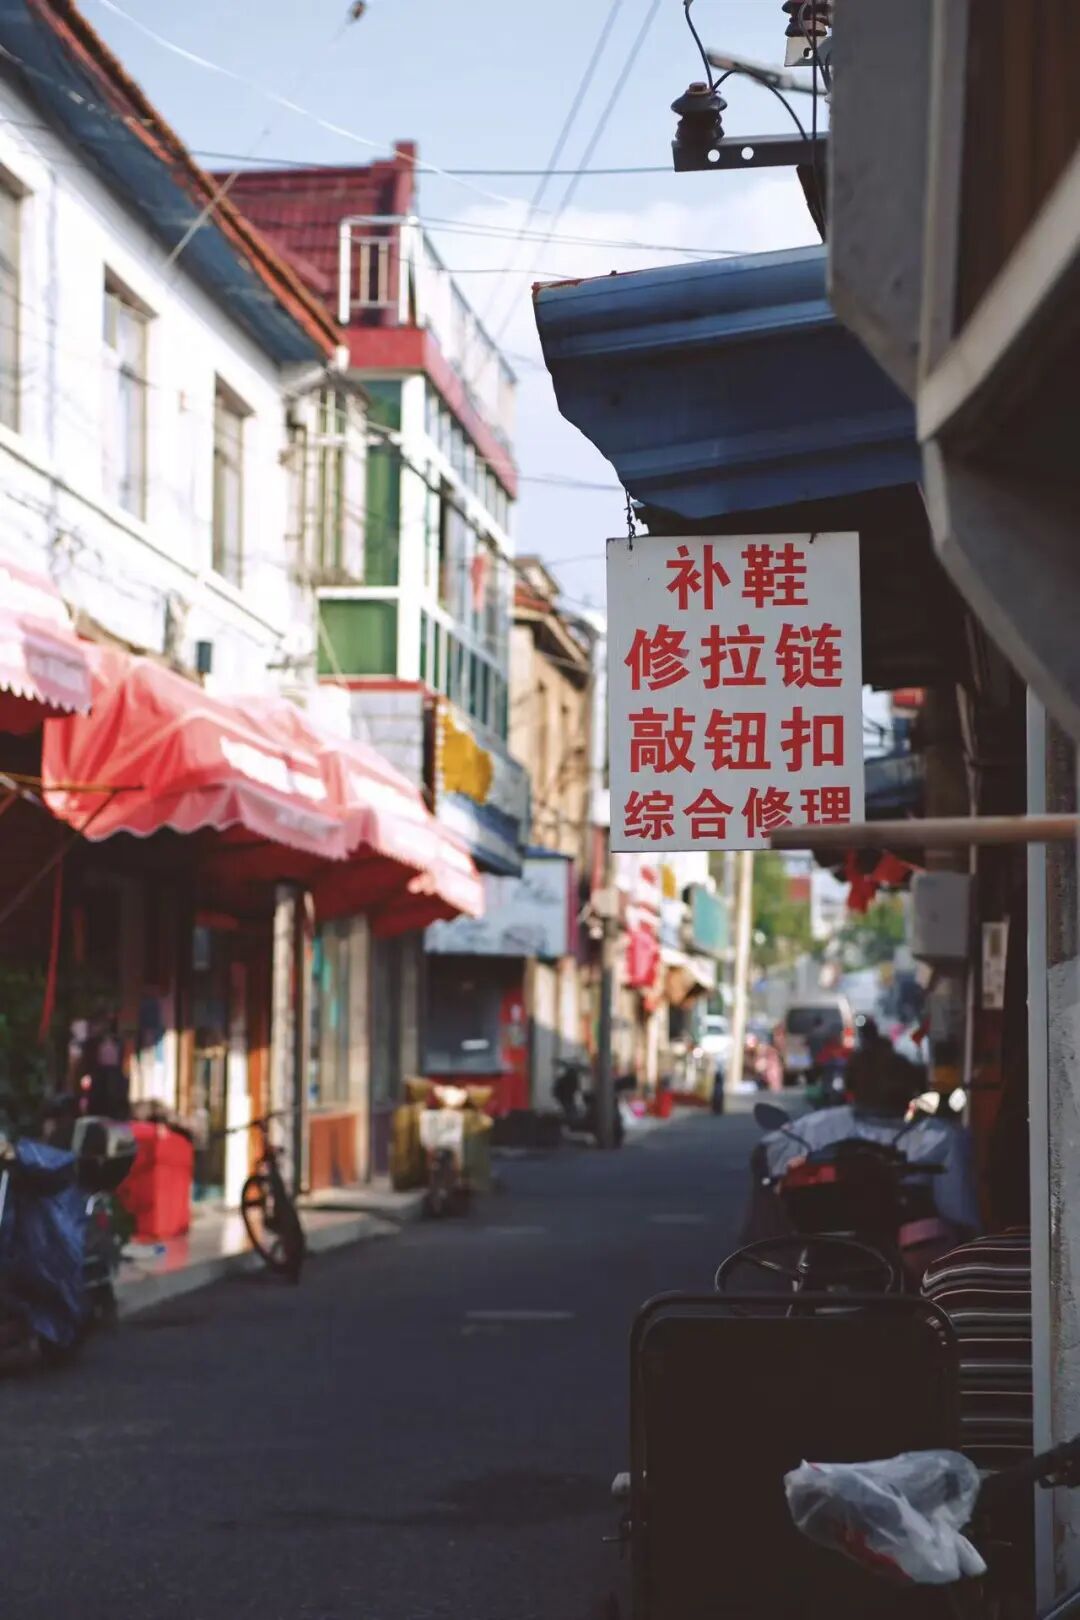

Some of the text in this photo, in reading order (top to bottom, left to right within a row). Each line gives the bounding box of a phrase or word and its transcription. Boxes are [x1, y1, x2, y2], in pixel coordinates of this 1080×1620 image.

[666, 543, 808, 611] 补鞋
[624, 623, 843, 692] 修拉链
[628, 706, 845, 774] 敲钮扣
[624, 786, 851, 841] 综合修理
